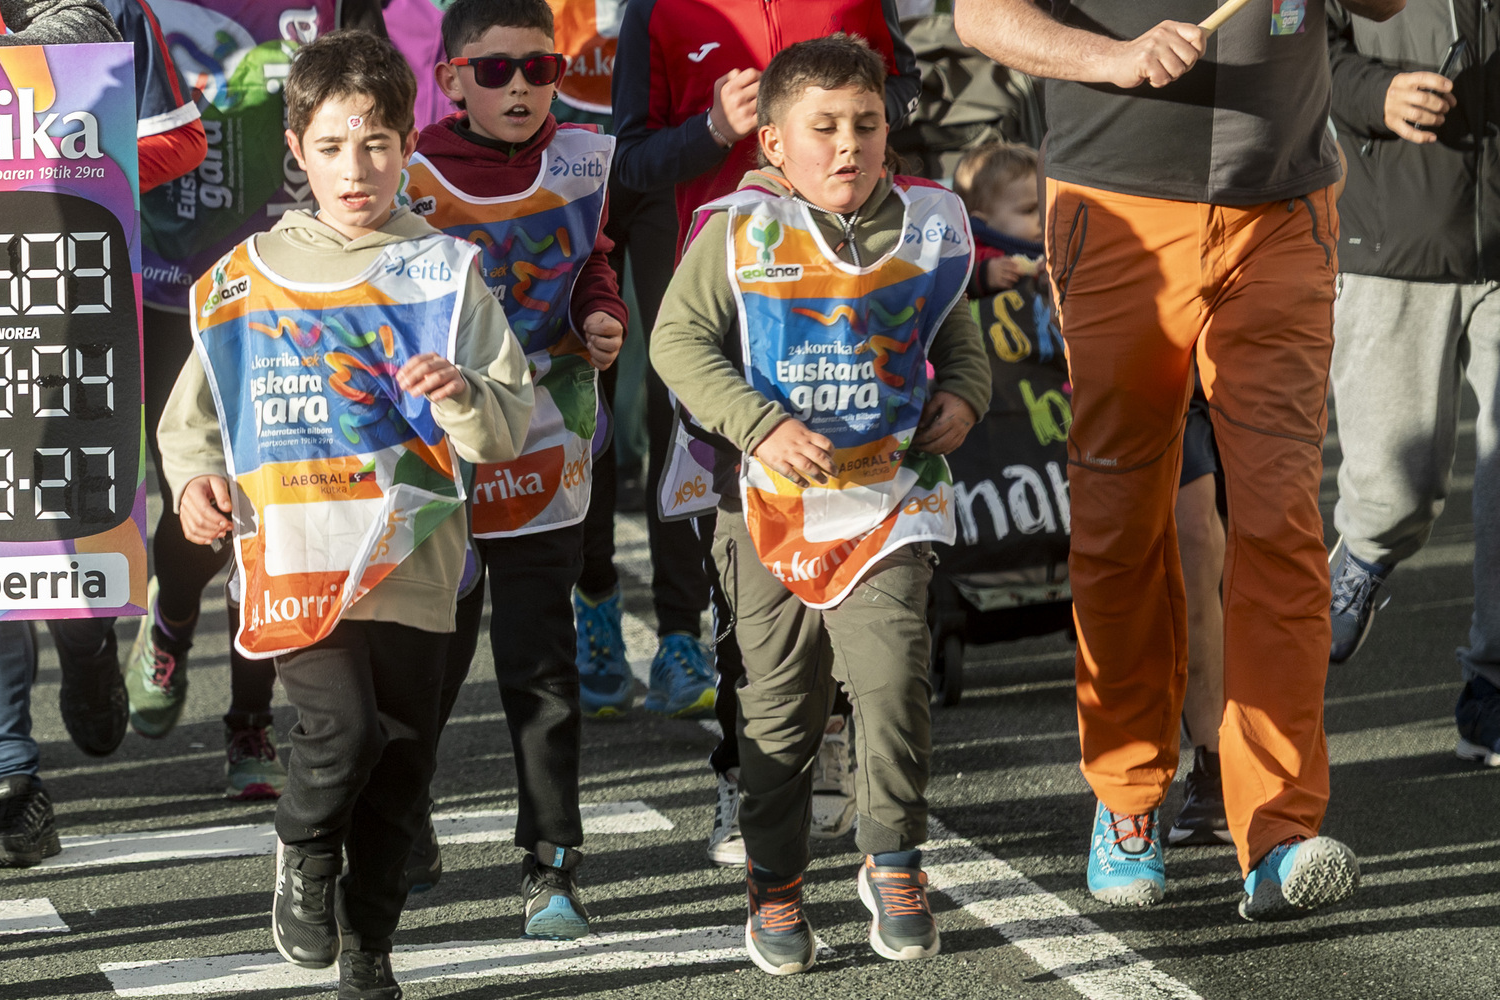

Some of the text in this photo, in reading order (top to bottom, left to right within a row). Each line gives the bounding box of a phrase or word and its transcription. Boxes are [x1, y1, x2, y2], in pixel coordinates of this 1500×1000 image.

[38, 165, 71, 180] 19tik
[75, 166, 105, 179] 29ra
[572, 157, 603, 177] eitb
[925, 222, 961, 244] eitb
[407, 261, 452, 282] eitb
[742, 265, 800, 279] goiener
[788, 341, 852, 356] 24.korrika
[776, 357, 875, 383] Euskara
[789, 382, 879, 421] gara
[562, 448, 590, 490] aek
[839, 454, 887, 474] ABORAL
[281, 474, 346, 487] LABORAL
[321, 485, 347, 494] kutxa
[903, 487, 949, 521] aek
